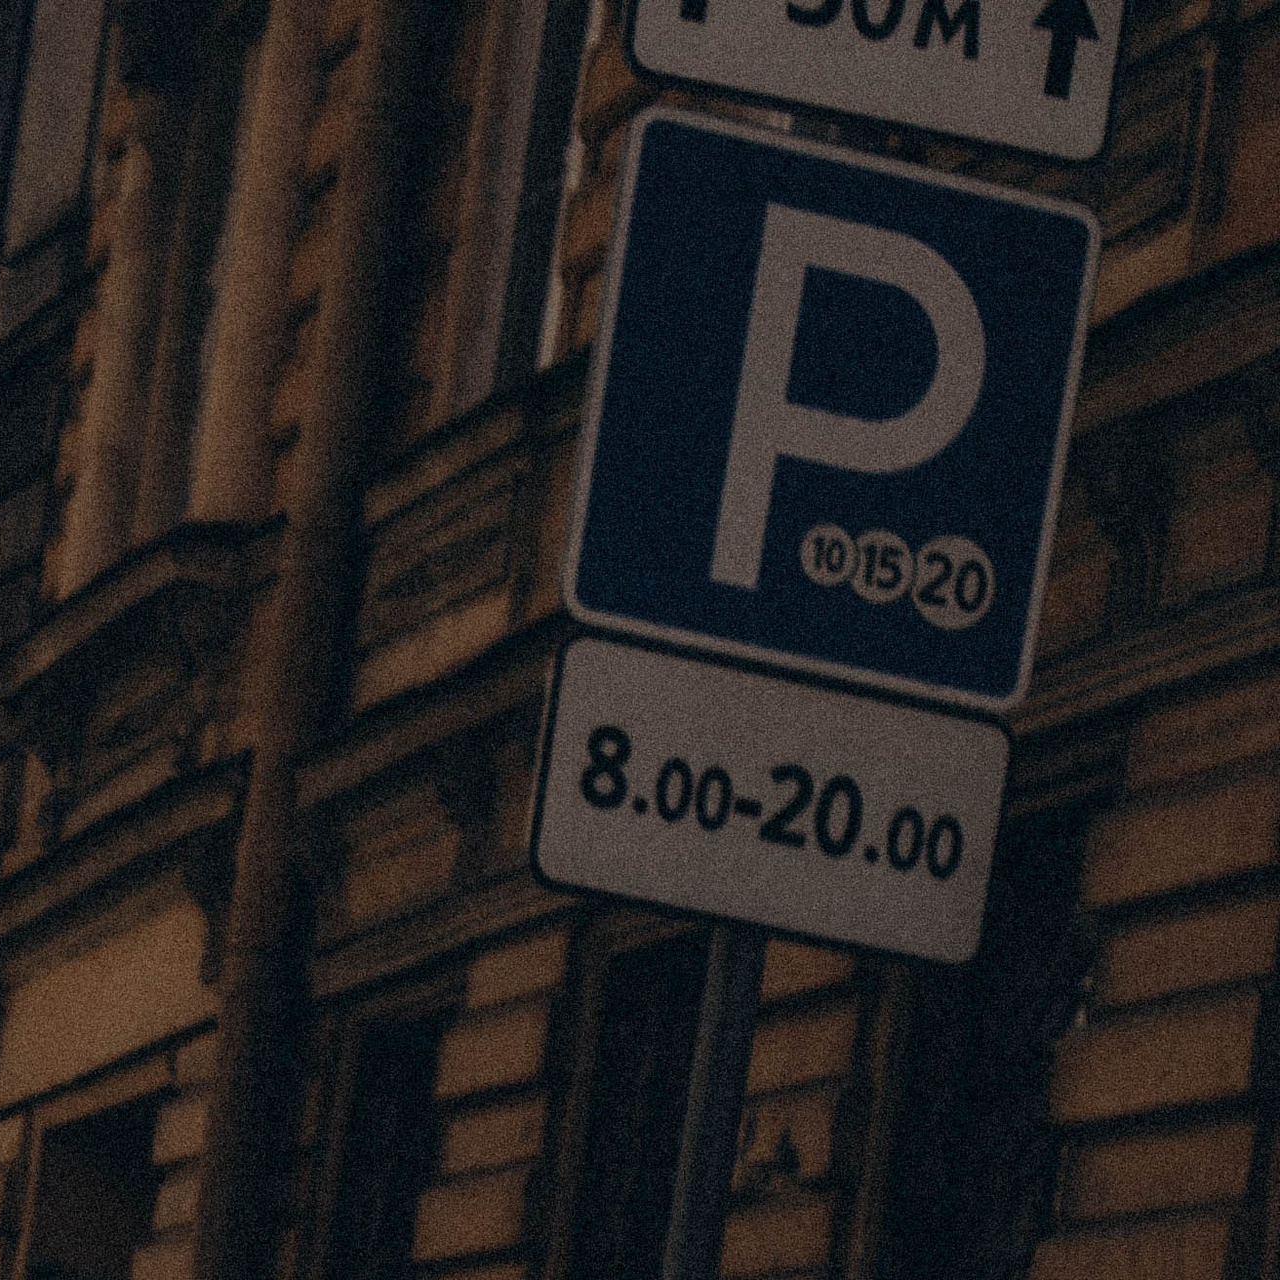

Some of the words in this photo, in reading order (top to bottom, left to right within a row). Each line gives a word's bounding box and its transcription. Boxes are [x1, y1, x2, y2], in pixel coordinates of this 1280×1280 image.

[710, 202, 986, 590] P
[814, 535, 846, 573] 10
[864, 544, 902, 589] 15
[919, 551, 987, 613] 20
[581, 726, 963, 879] 8.00-20.00
